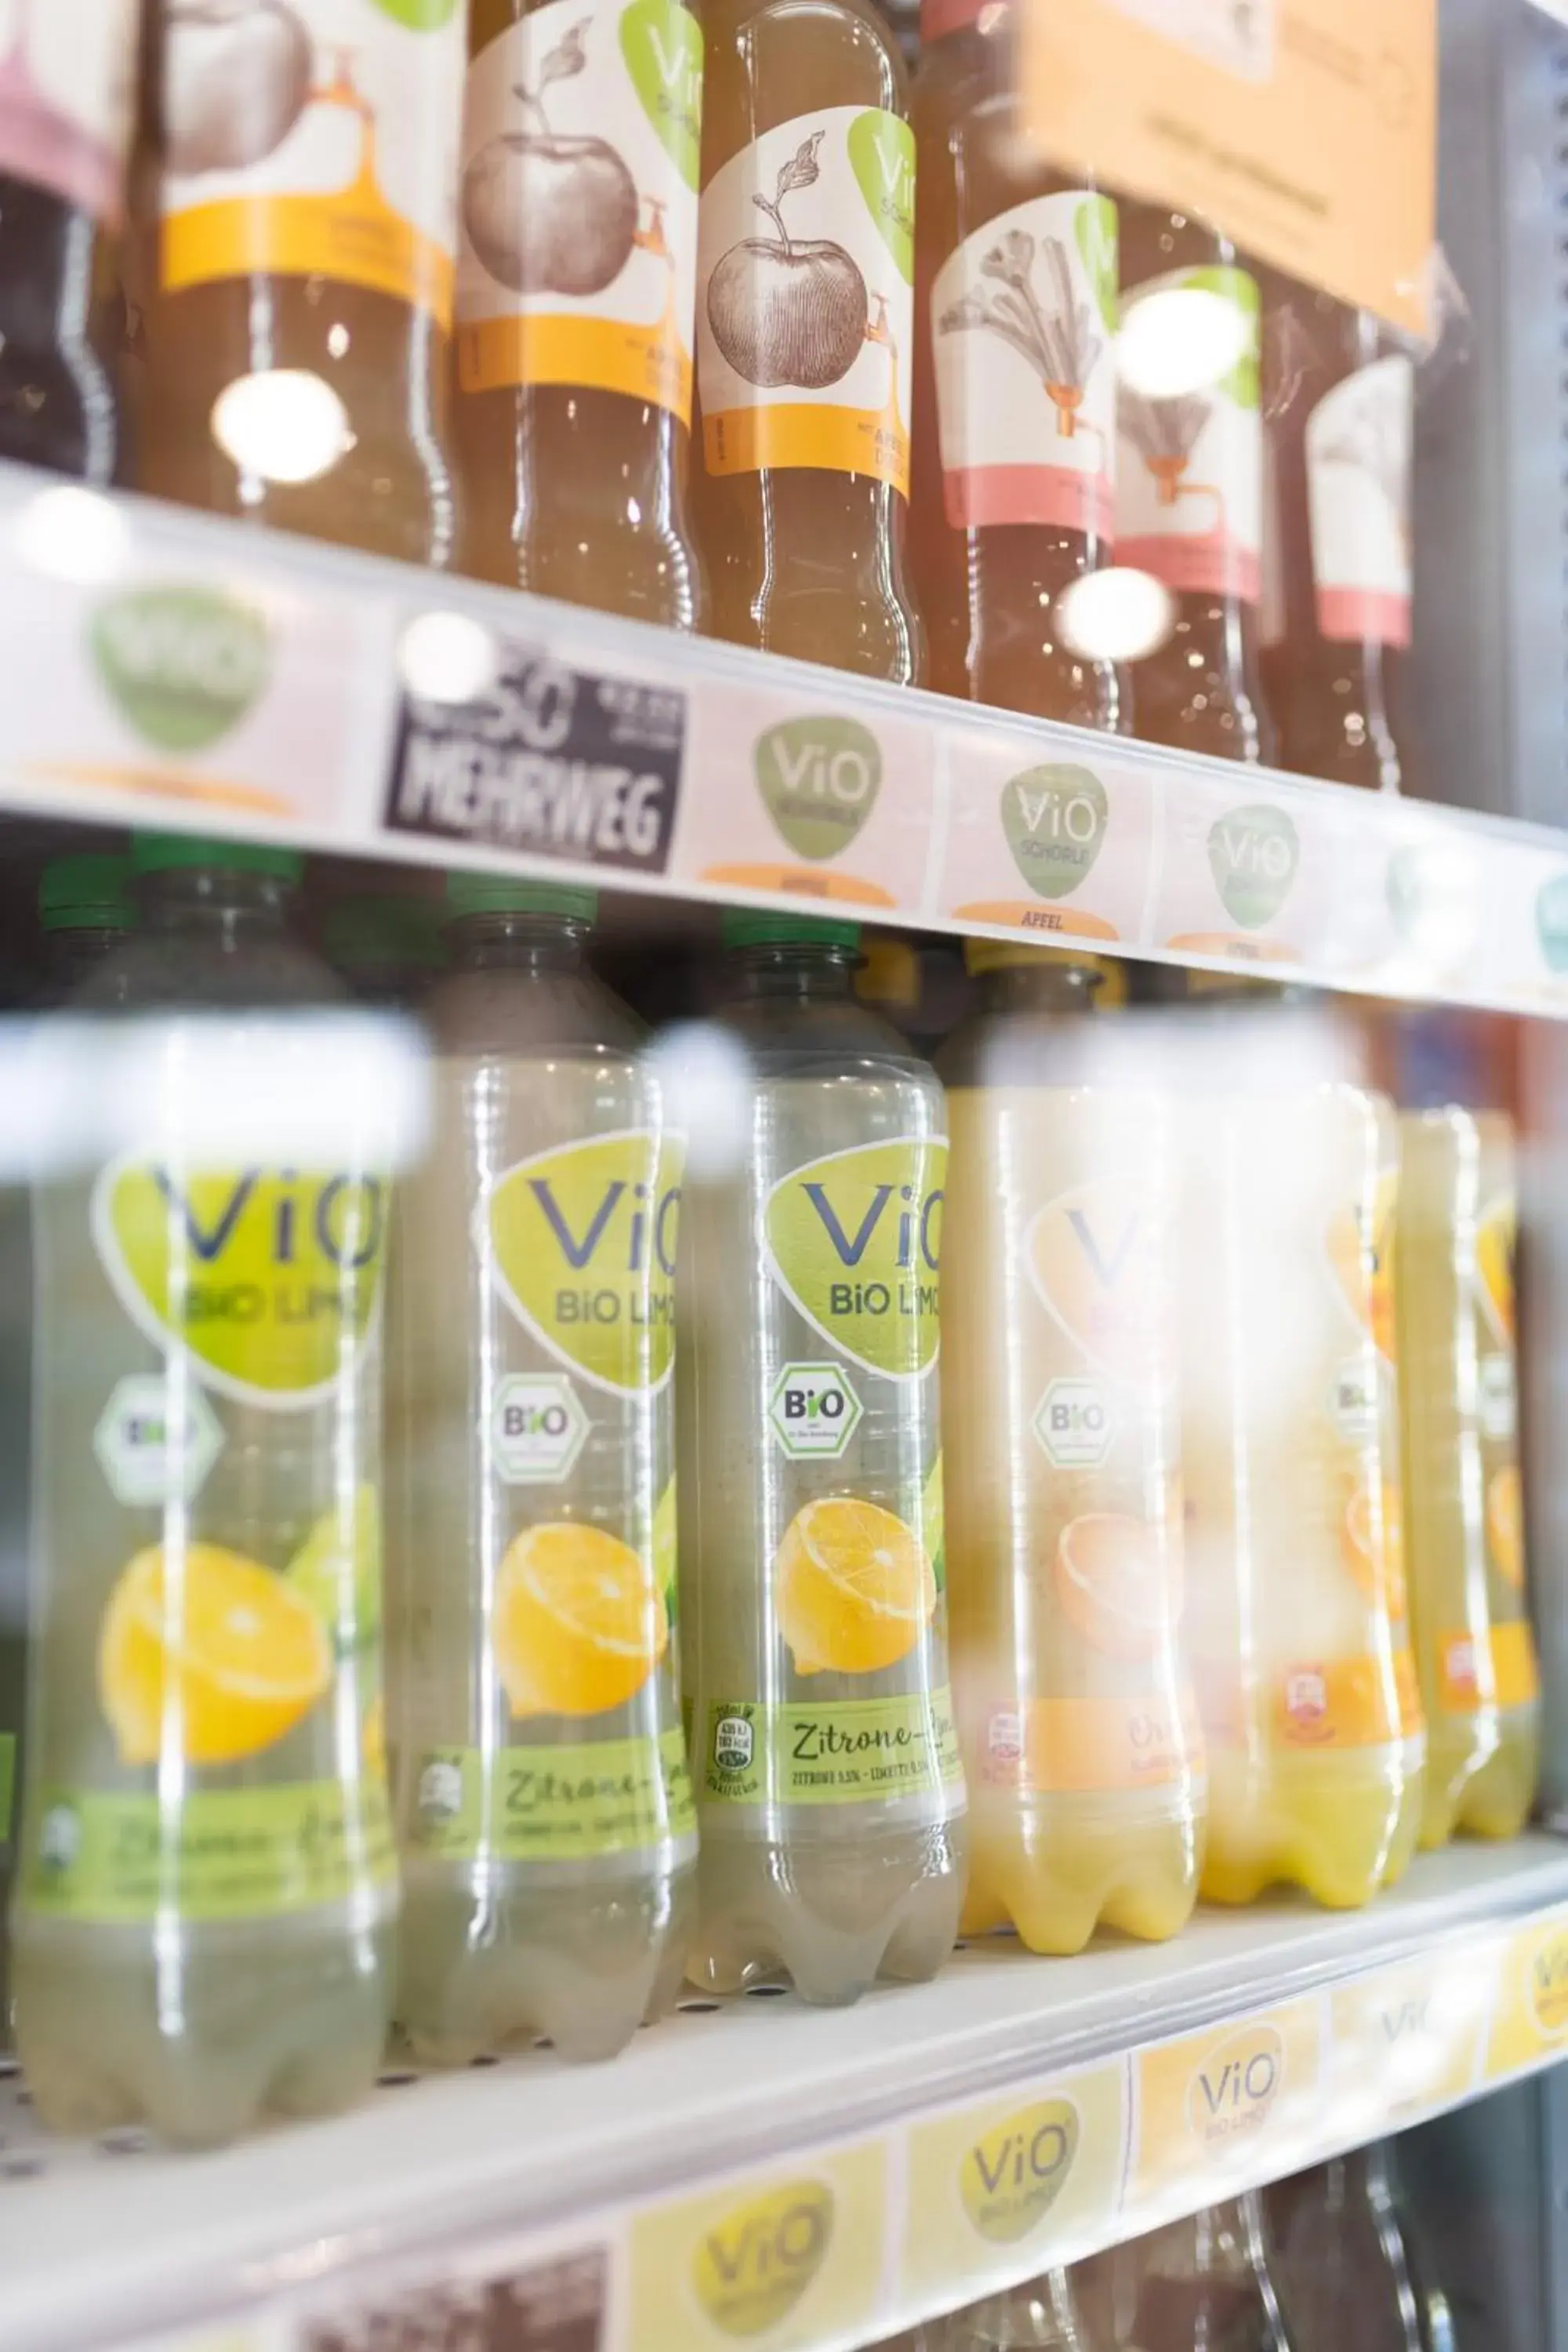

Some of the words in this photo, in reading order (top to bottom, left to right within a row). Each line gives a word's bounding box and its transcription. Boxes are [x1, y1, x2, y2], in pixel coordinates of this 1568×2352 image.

[398, 733, 668, 857] MEHRWEG
[770, 735, 869, 803] ViO
[1015, 785, 1097, 842] ViO
[1221, 824, 1292, 878] ViO
[1020, 910, 1064, 931] APFEL
[555, 1290, 625, 1324] BiO
[830, 1283, 890, 1316] BiO
[504, 1405, 568, 1438] BiO
[786, 1388, 844, 1419] BiO
[1198, 2053, 1276, 2115] ViO
[973, 2124, 1067, 2194] ViO
[707, 2205, 825, 2281] ViO
